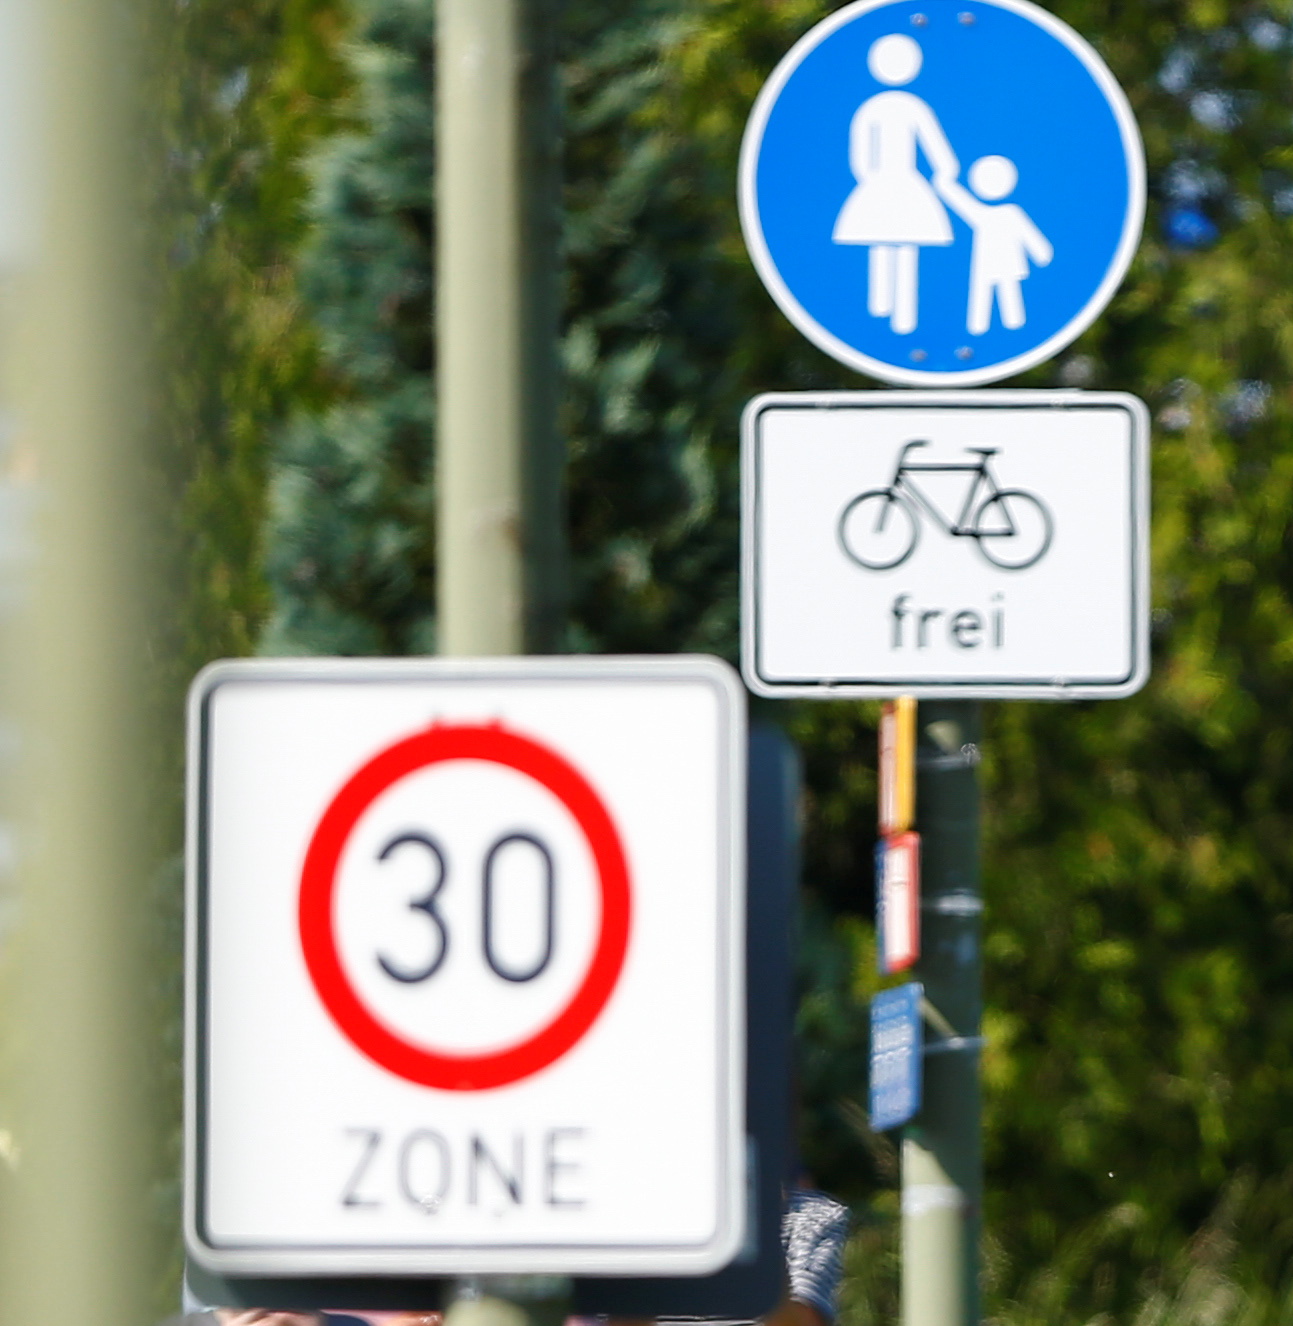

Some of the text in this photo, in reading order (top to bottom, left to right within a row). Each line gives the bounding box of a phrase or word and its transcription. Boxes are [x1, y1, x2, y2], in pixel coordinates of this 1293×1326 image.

[889, 590, 1006, 650] frei
[373, 829, 557, 984] 30
[340, 1124, 592, 1212] ZONE
